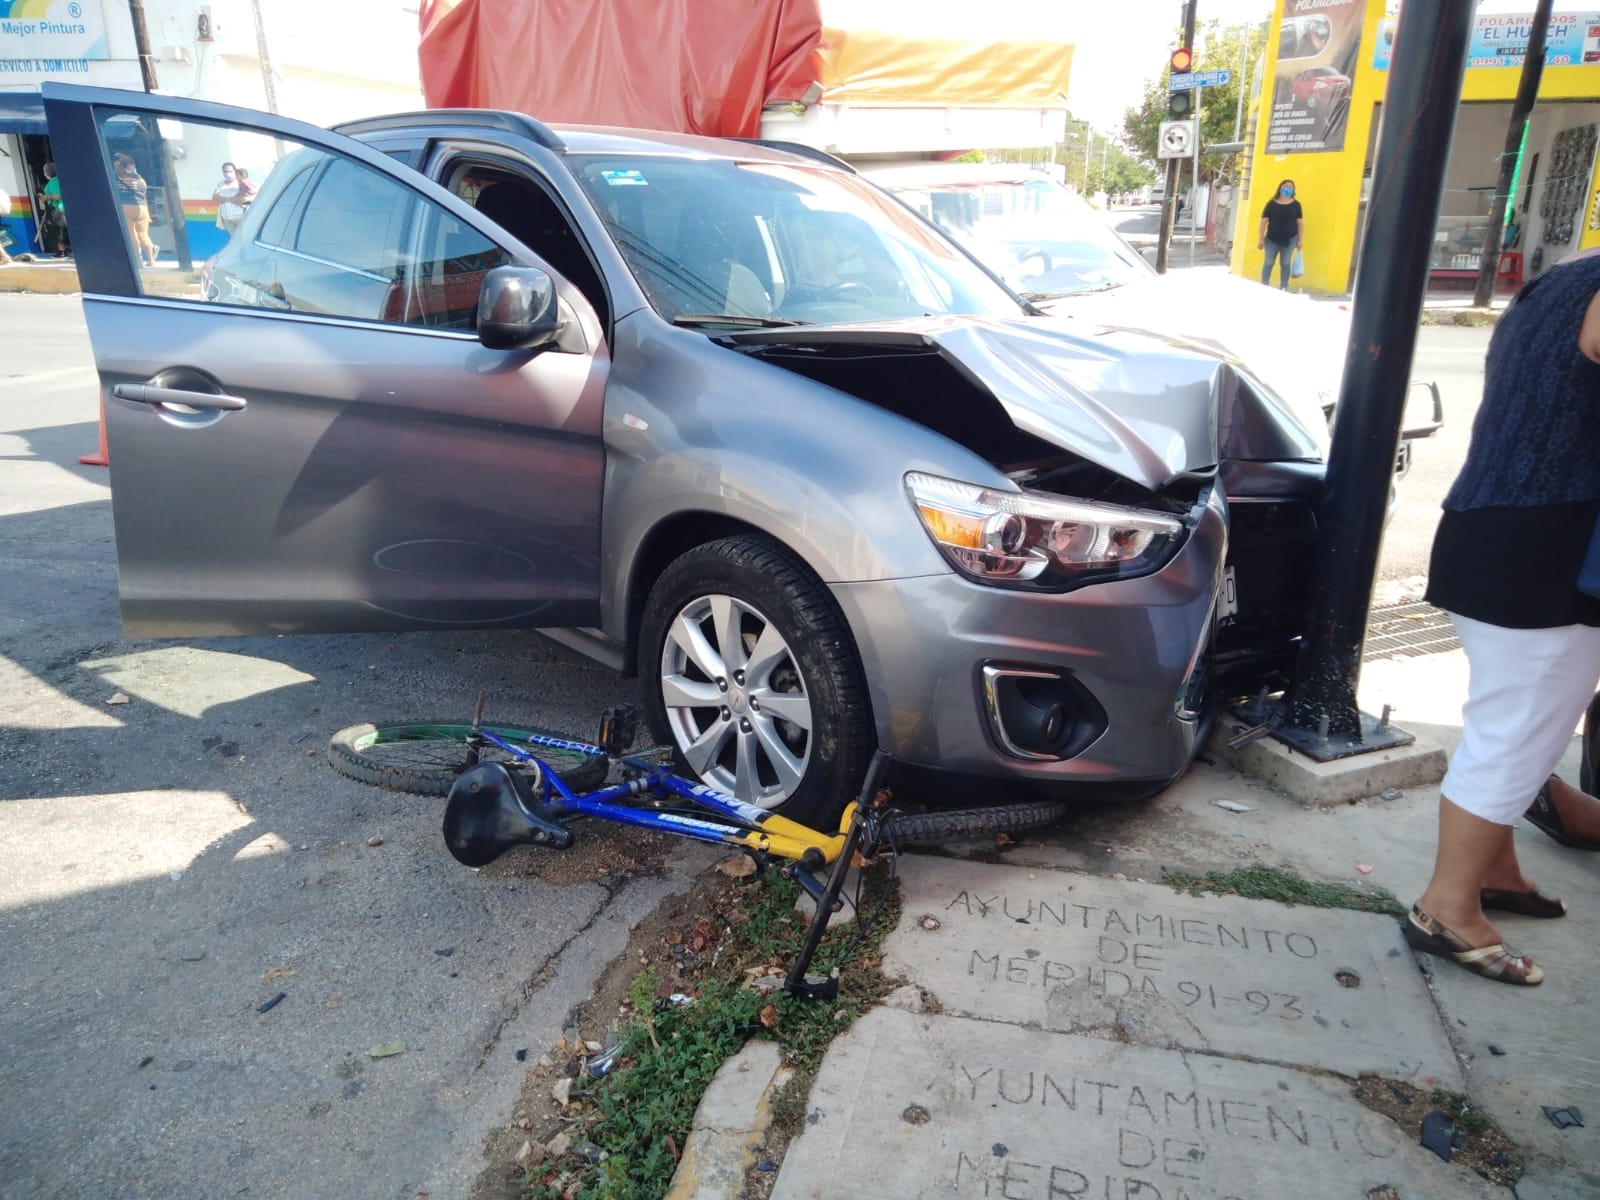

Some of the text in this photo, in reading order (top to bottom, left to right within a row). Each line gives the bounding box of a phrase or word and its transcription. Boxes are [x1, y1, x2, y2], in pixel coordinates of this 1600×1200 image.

[2, 22, 85, 37] Mejor Pintura
[1479, 15, 1576, 27] POLARIZDOS
[1506, 24, 1576, 39] HUCH”
[36, 60, 41, 72] A
[43, 60, 89, 72] DOMICILIO
[945, 890, 1318, 959] AYUNTAMIENTO
[1097, 935, 1164, 971] DE
[968, 950, 1160, 999] MERIDA
[1118, 1127, 1203, 1178] DE
